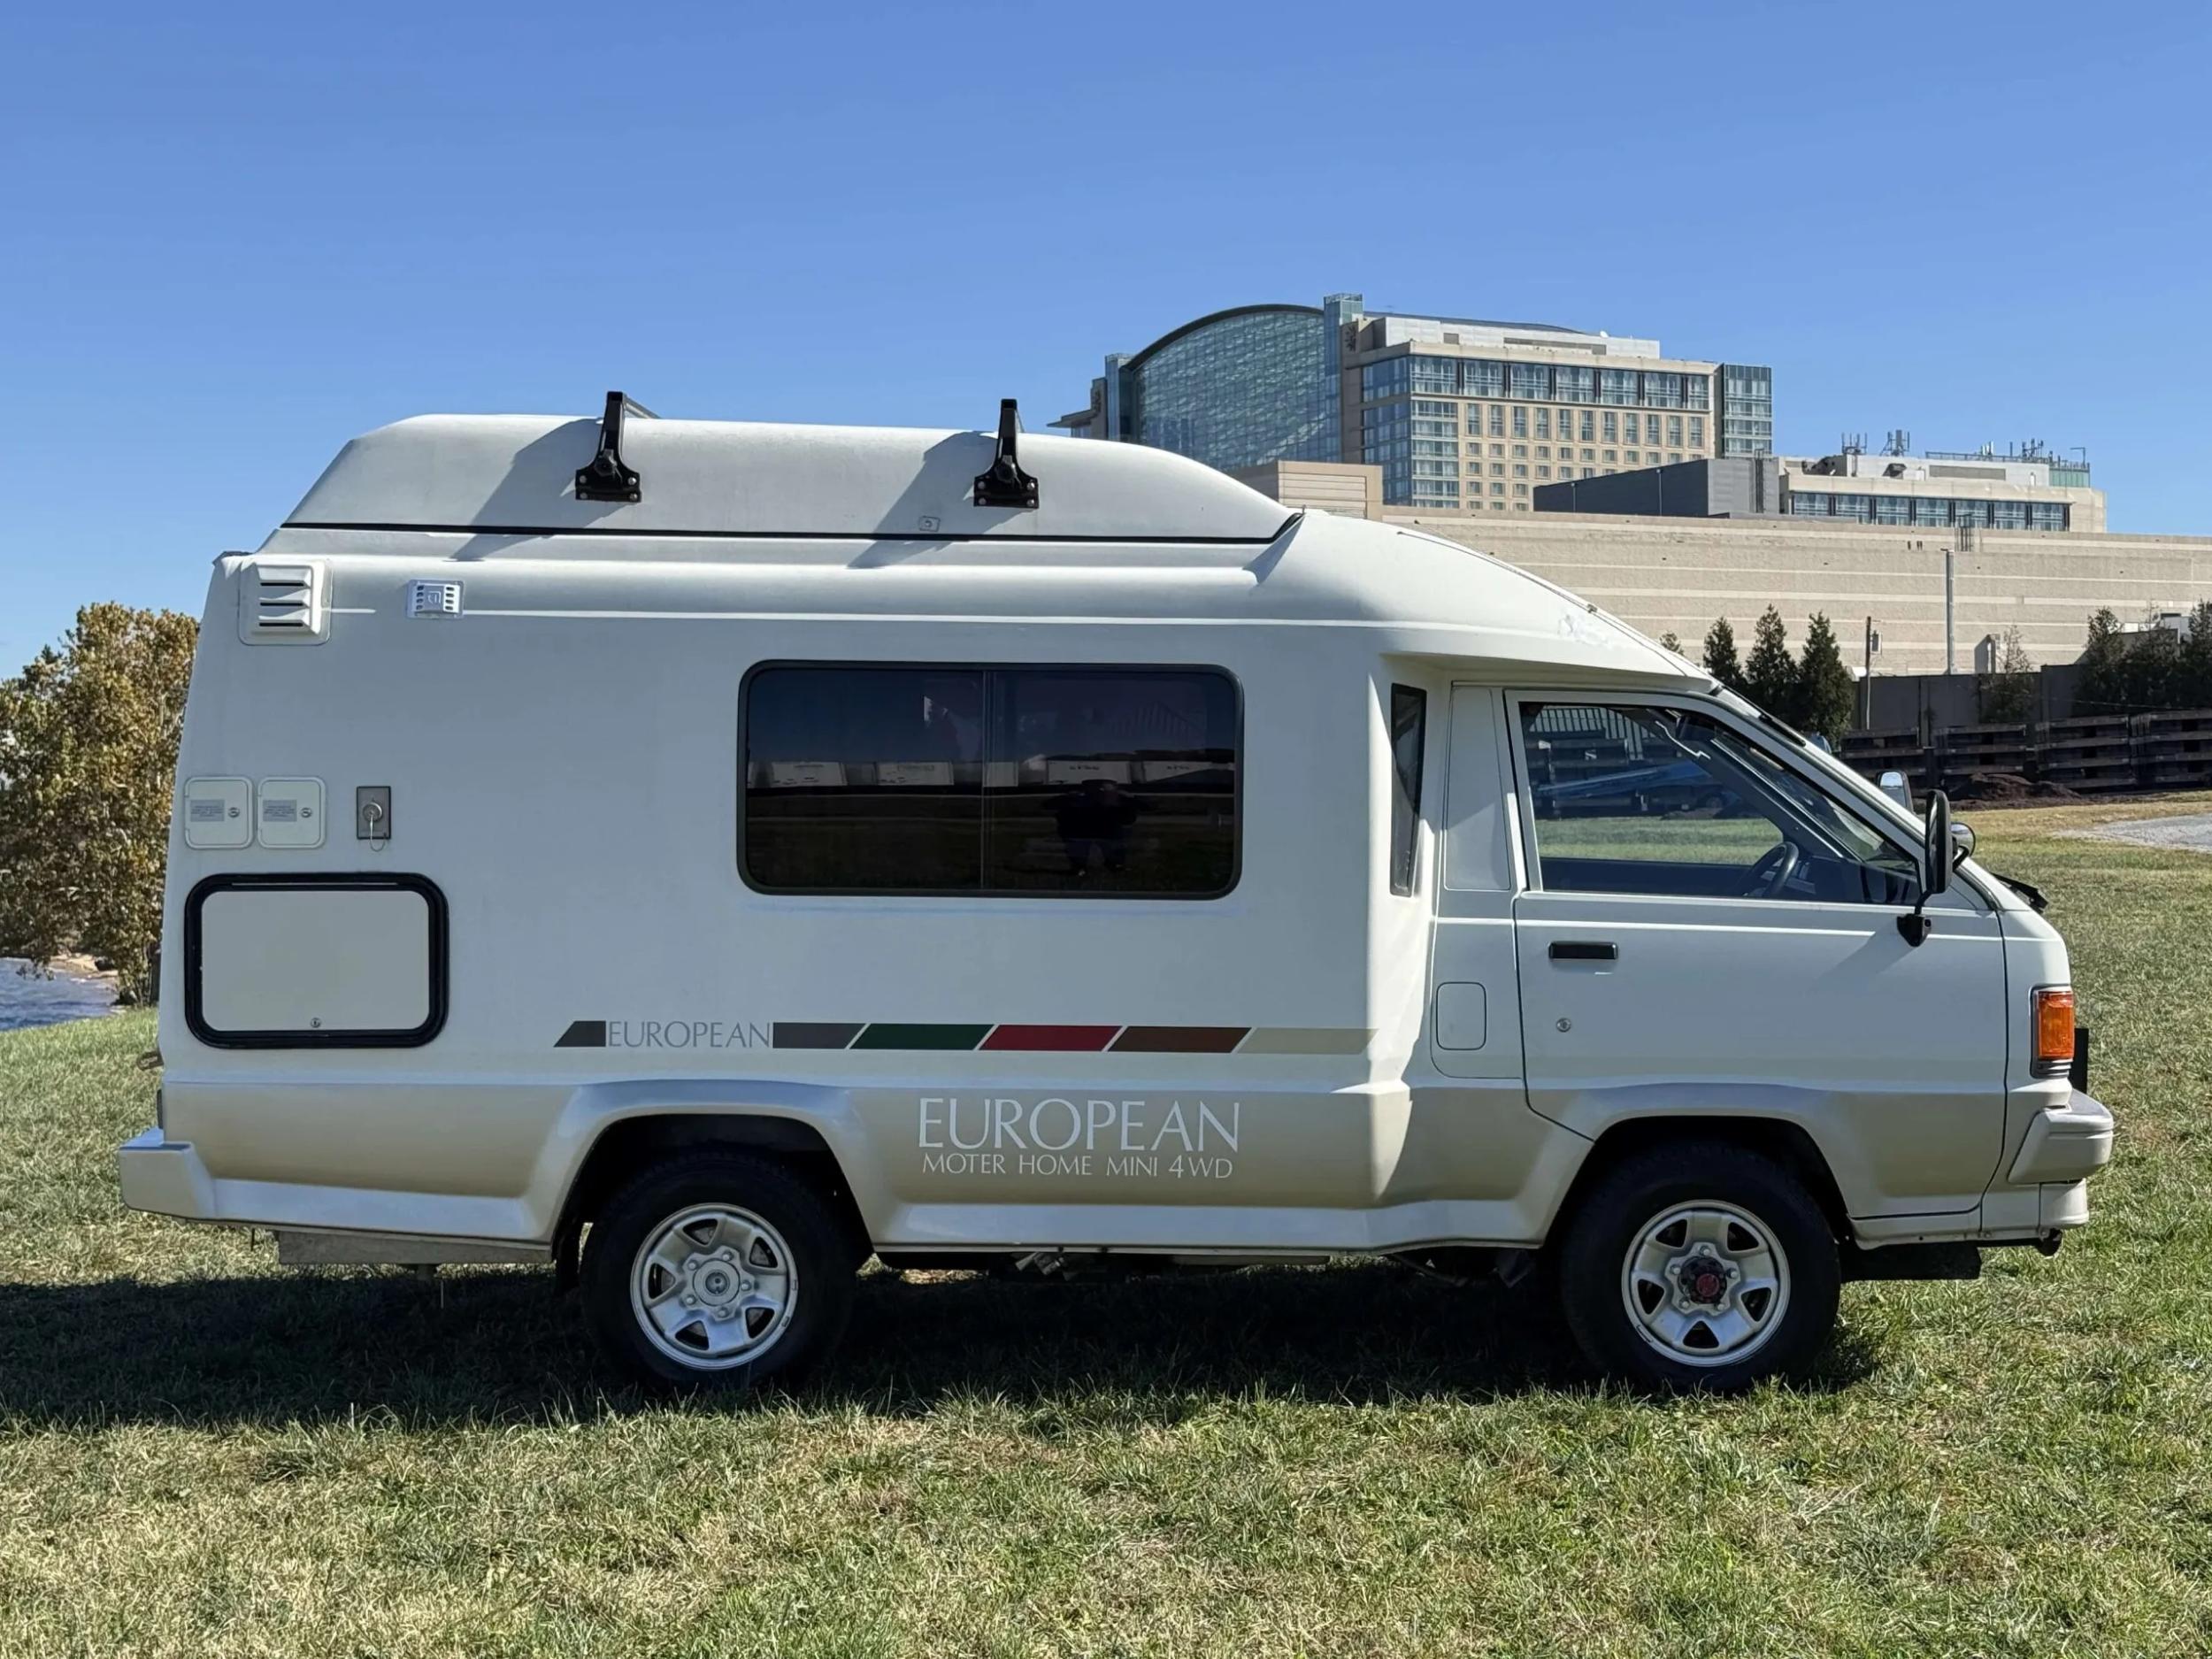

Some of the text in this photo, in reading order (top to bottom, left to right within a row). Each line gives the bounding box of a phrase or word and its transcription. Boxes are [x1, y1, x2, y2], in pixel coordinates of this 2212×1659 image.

[608, 1020, 770, 1048] EUROPEAN
[918, 1097, 1240, 1153] EUROPEAN
[922, 1152, 1233, 1179] MOTER HOME MINI 4WD
